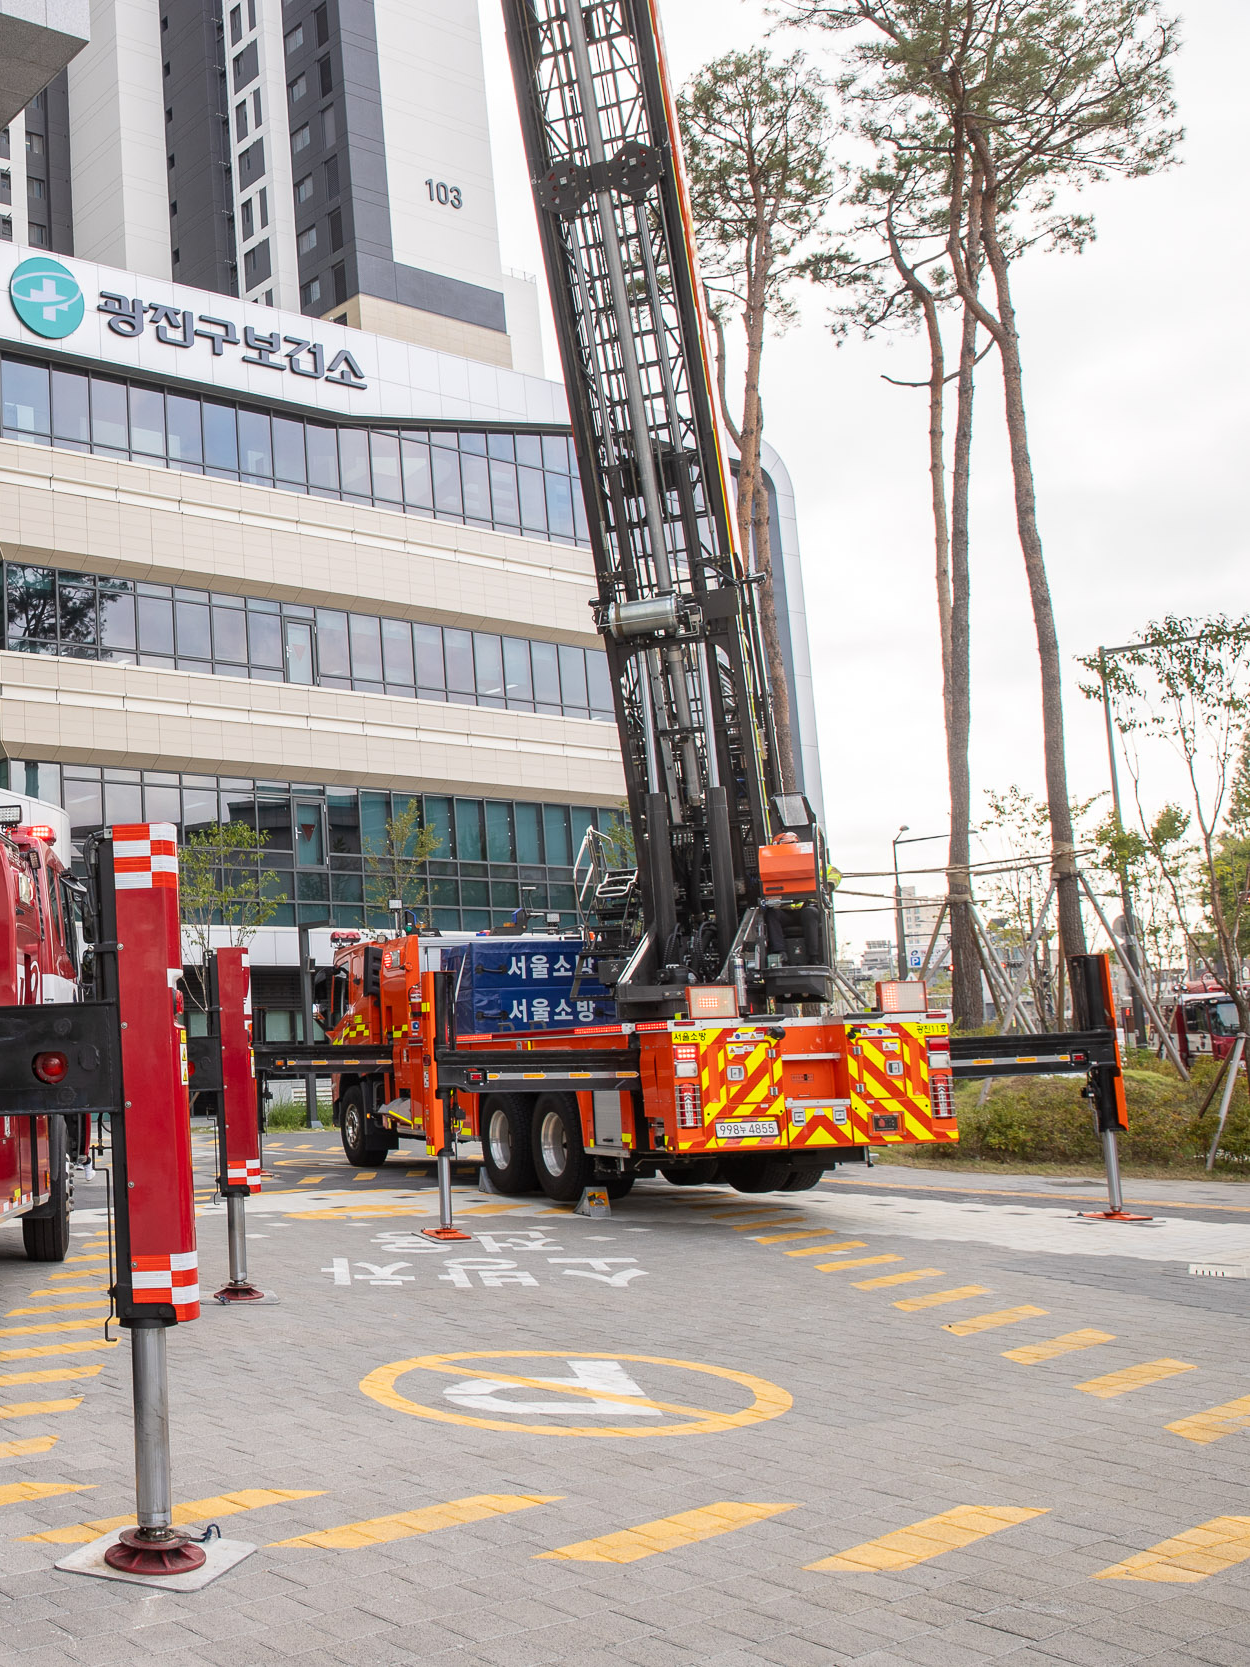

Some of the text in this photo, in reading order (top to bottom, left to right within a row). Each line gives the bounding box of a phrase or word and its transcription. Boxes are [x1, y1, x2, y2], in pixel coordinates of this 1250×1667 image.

[425, 178, 463, 210] 103
[97, 290, 368, 390] 광진구보건소
[509, 997, 596, 1023] 서울소방
[673, 1032, 707, 1042] 서울소방
[719, 1123, 775, 1135] 998누 4855
[370, 1230, 564, 1253] 전용
[320, 1257, 650, 1288] 소방차
